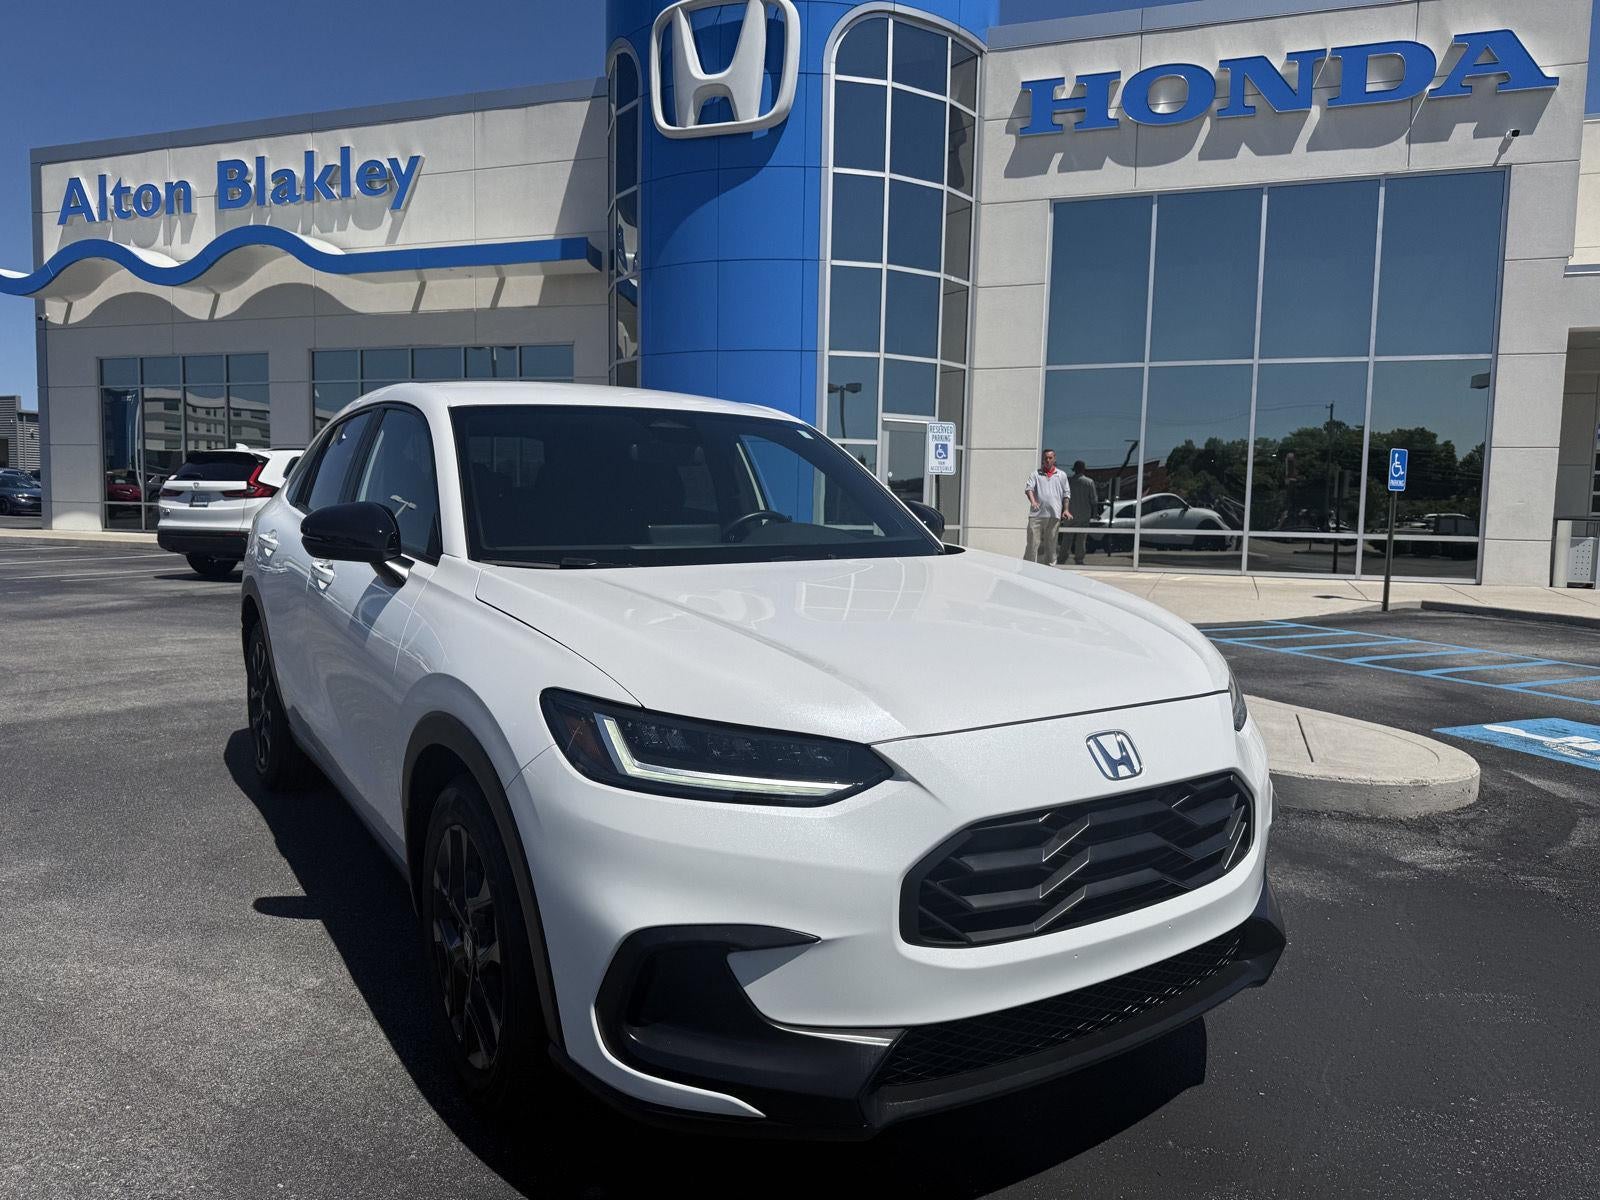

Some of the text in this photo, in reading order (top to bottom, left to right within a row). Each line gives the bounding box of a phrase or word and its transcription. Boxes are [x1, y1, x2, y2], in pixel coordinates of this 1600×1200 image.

[1019, 29, 1559, 136] HONDA
[57, 146, 422, 226] Alton Blakley
[930, 425, 953, 434] RESERVED
